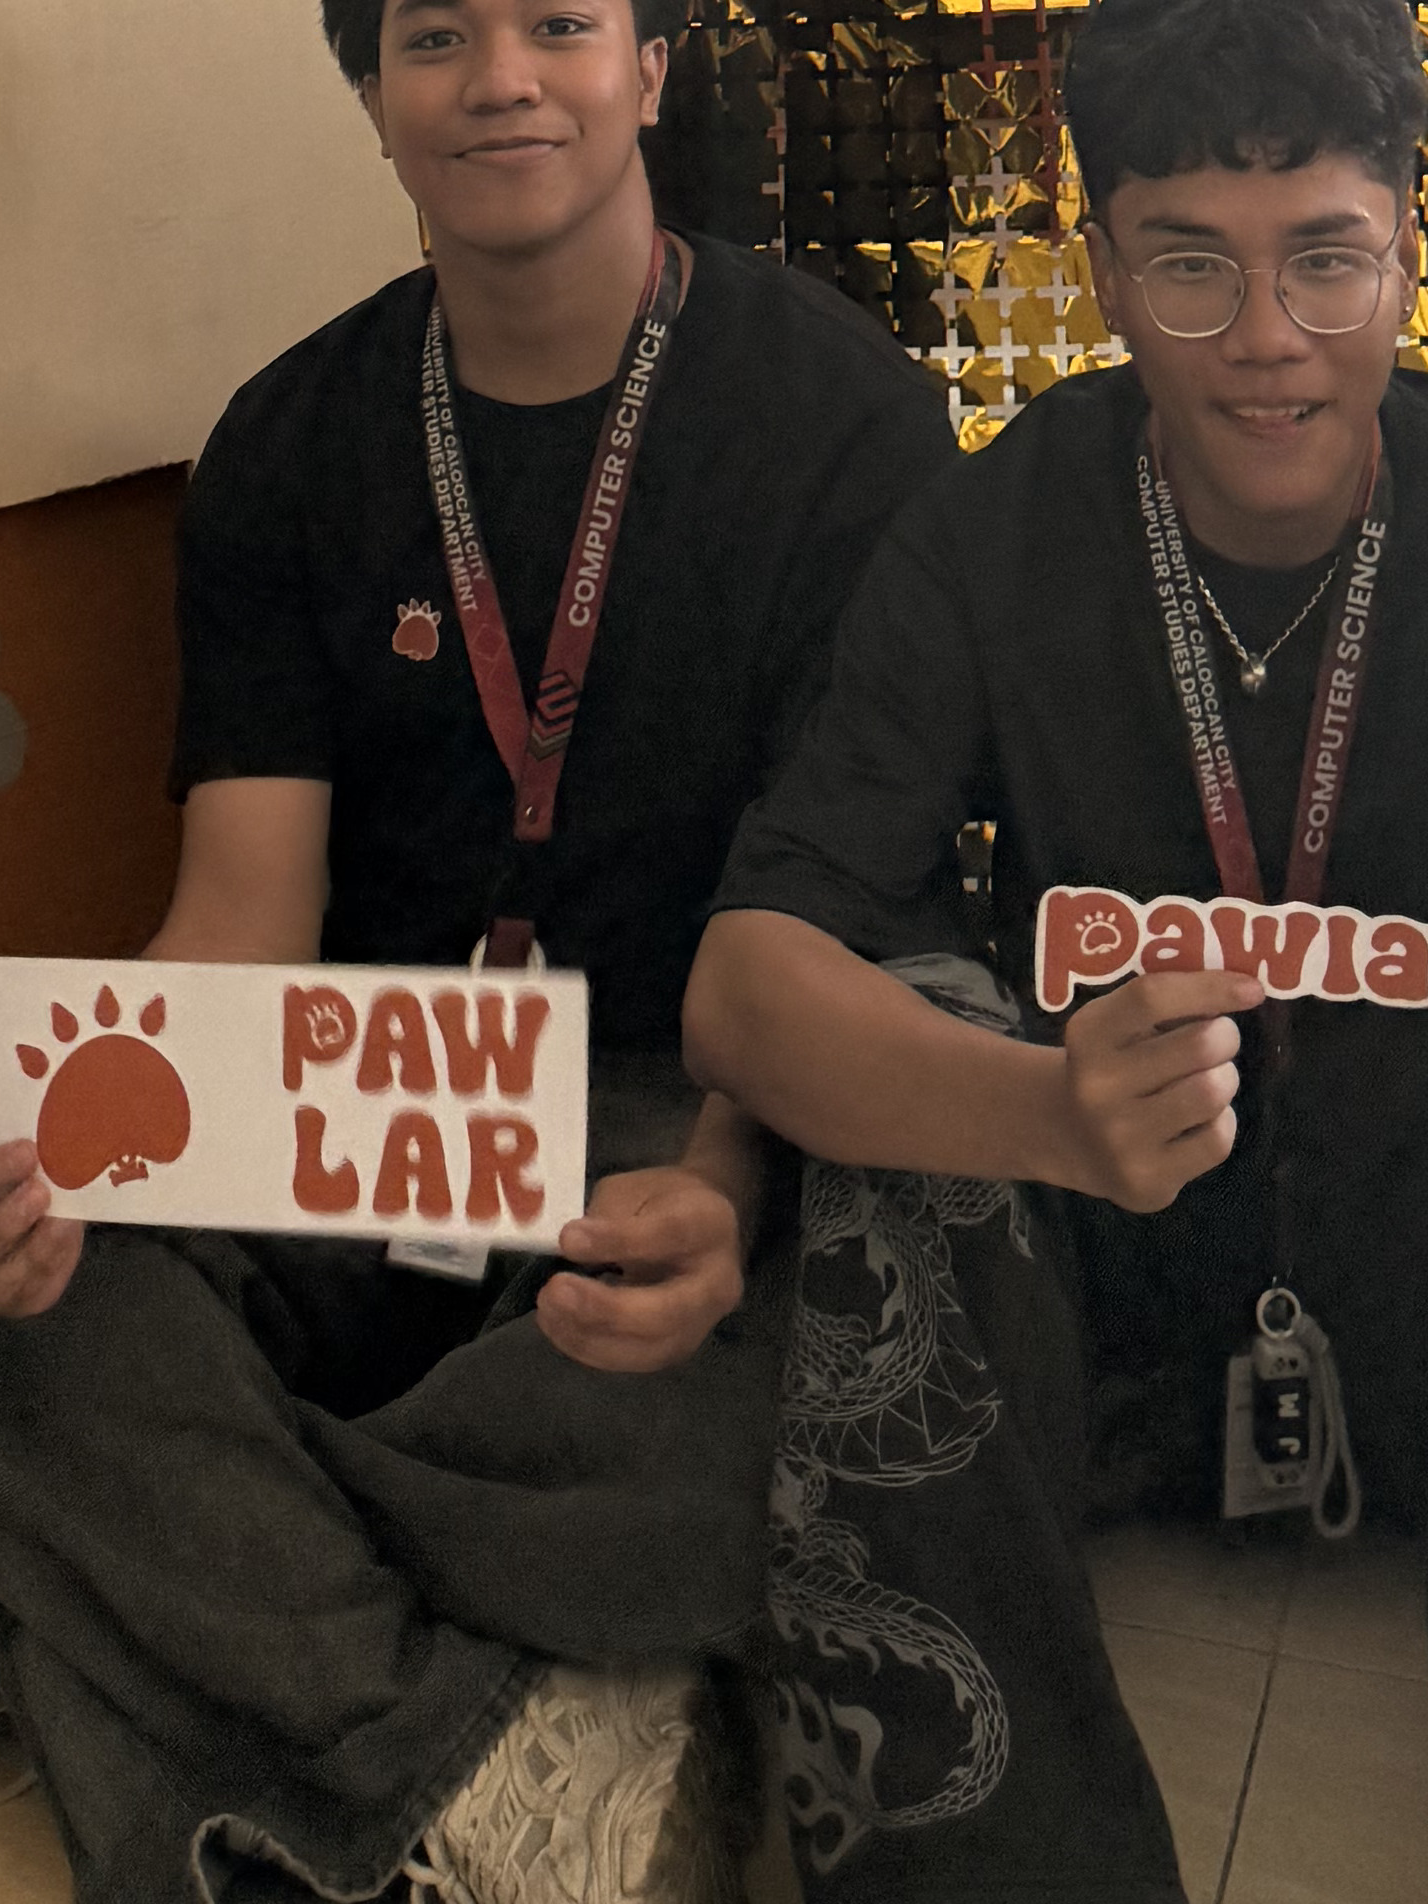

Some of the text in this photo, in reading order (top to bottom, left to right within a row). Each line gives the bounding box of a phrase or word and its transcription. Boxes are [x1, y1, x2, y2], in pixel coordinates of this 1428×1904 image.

[422, 395, 447, 477] STUDIES
[435, 478, 479, 612] DEPARTMENT
[430, 306, 488, 580] UNIVERSITY OF CALOOCAN CITY
[568, 318, 667, 628] COMPUTER SCIENCE
[1137, 454, 1228, 826] COMPUTER STUDIES DEPARTMENT
[1154, 479, 1238, 791] UNIVERSITY OF CALOOCAN CITY
[1303, 517, 1387, 854] COMPUTER SCIENCE
[282, 983, 552, 1102] PAW
[292, 1104, 548, 1226] LAR
